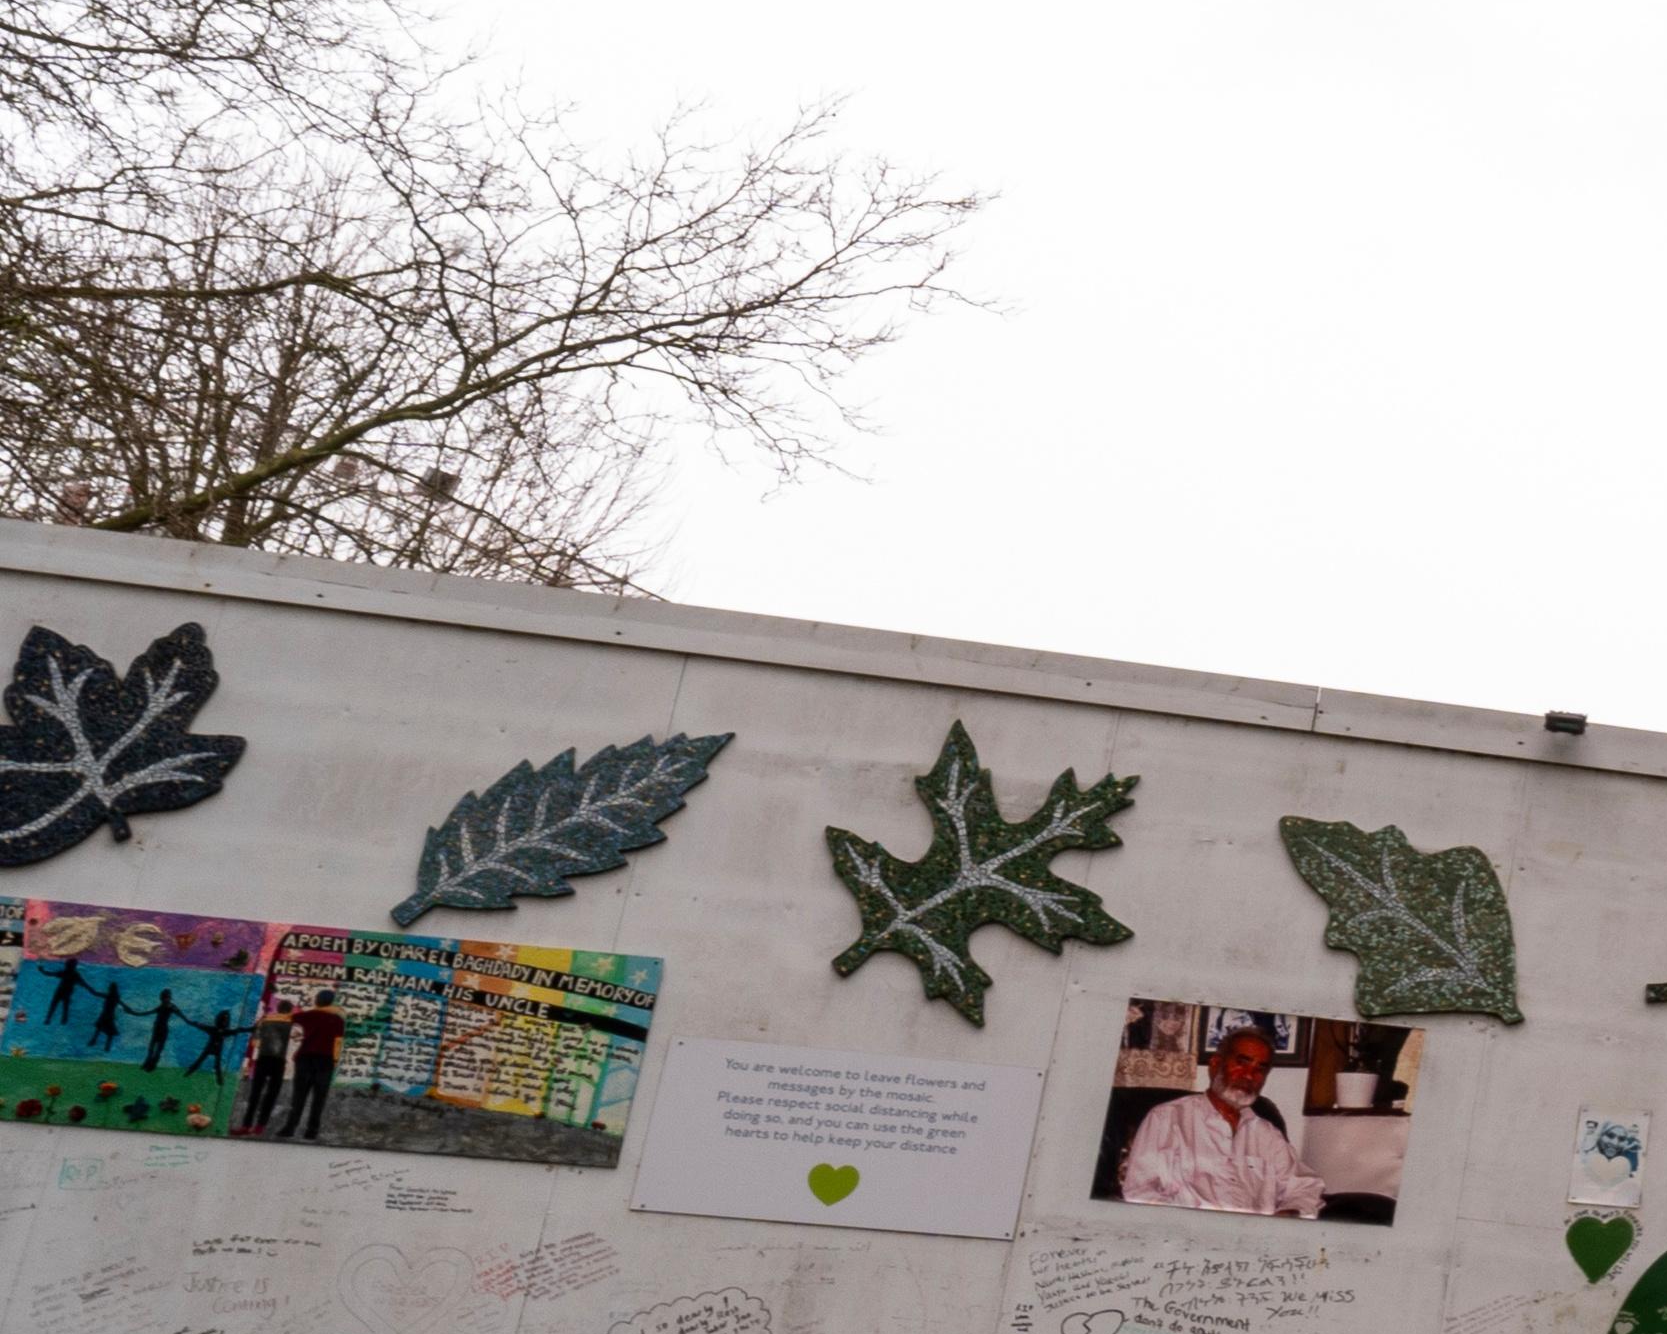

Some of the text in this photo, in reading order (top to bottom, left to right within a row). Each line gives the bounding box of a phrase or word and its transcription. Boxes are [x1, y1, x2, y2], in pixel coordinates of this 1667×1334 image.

[298, 935, 347, 954] POEM
[352, 940, 377, 958] BY
[379, 941, 428, 962] OMAR
[429, 949, 451, 967] EL
[453, 953, 533, 984] BAGHDADY
[533, 971, 554, 988] IN
[559, 976, 634, 1003] MEMORY
[634, 989, 655, 1008] OF
[273, 960, 348, 980] HESHAM
[442, 983, 474, 1002] HIS
[485, 994, 550, 1018] UNCLE
[725, 1058, 987, 1091] You are welcome to leave flowers and
[716, 1091, 979, 1124] Please respect social distancing while
[767, 1080, 937, 1104] messages by the mosaic.
[722, 1109, 761, 1125] doing
[787, 1114, 814, 1127] and
[816, 1118, 842, 1133] you
[845, 1120, 870, 1132] can
[872, 1123, 898, 1135] use
[900, 1123, 925, 1136] the
[926, 1126, 967, 1142] green
[724, 1125, 959, 1155] hearts to help keep your distance
[1131, 1295, 1250, 1331] The Government
